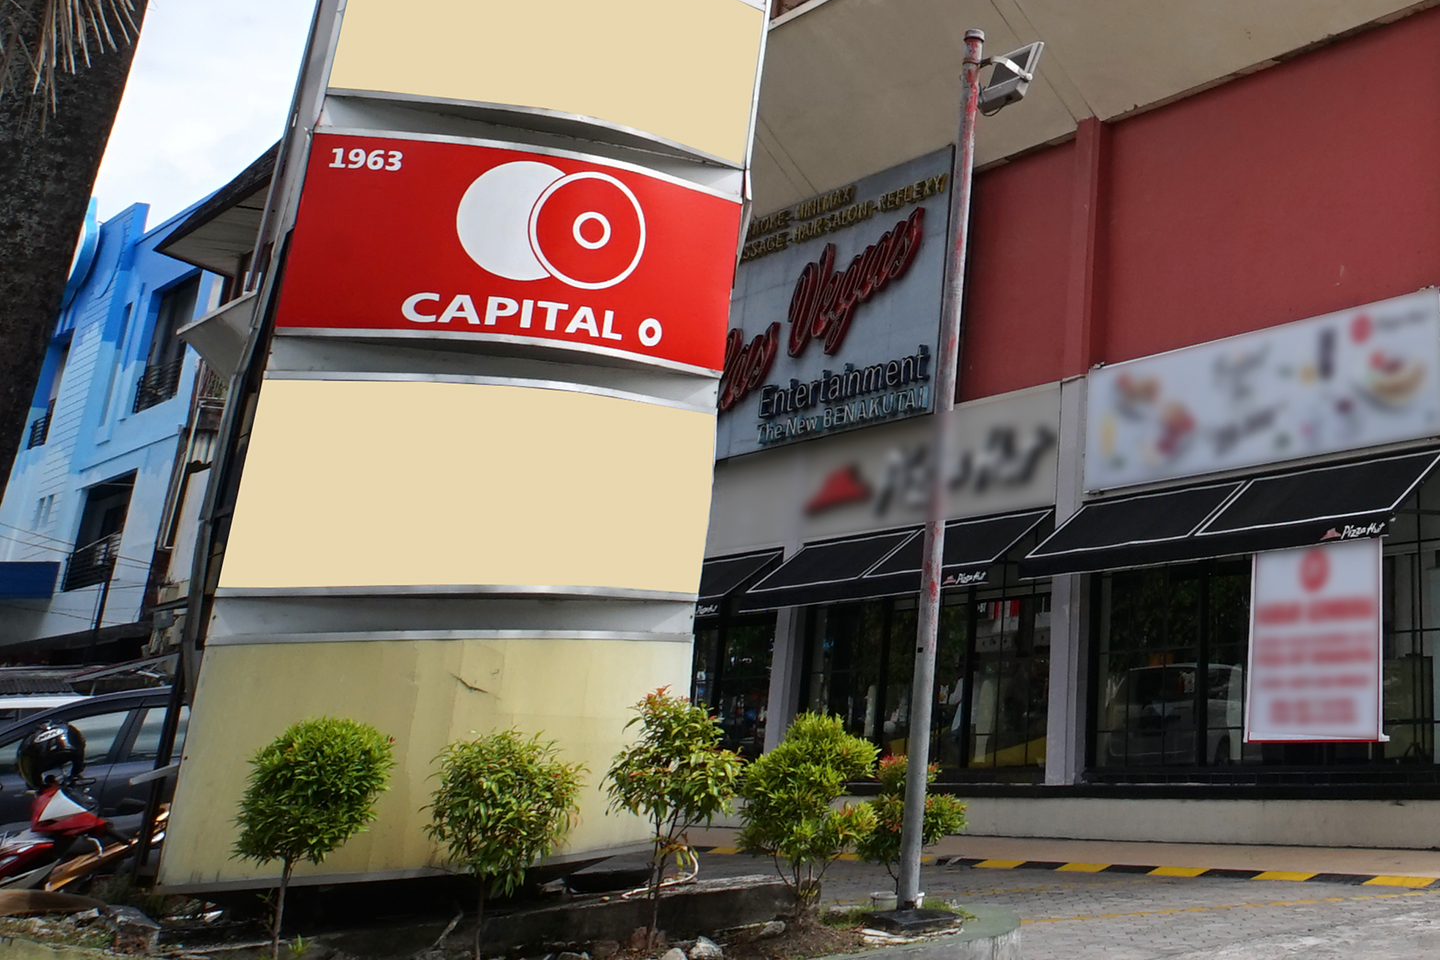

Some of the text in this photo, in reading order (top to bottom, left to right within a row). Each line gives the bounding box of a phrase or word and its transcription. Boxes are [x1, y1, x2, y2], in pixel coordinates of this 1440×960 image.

[328, 147, 403, 172] 1963
[787, 207, 926, 358] Vegas
[401, 292, 662, 347] CAPITAL O
[758, 344, 931, 419] Entertainment
[757, 386, 929, 444] The New BENAKUTAI
[1341, 522, 1385, 539] Pizza Hut
